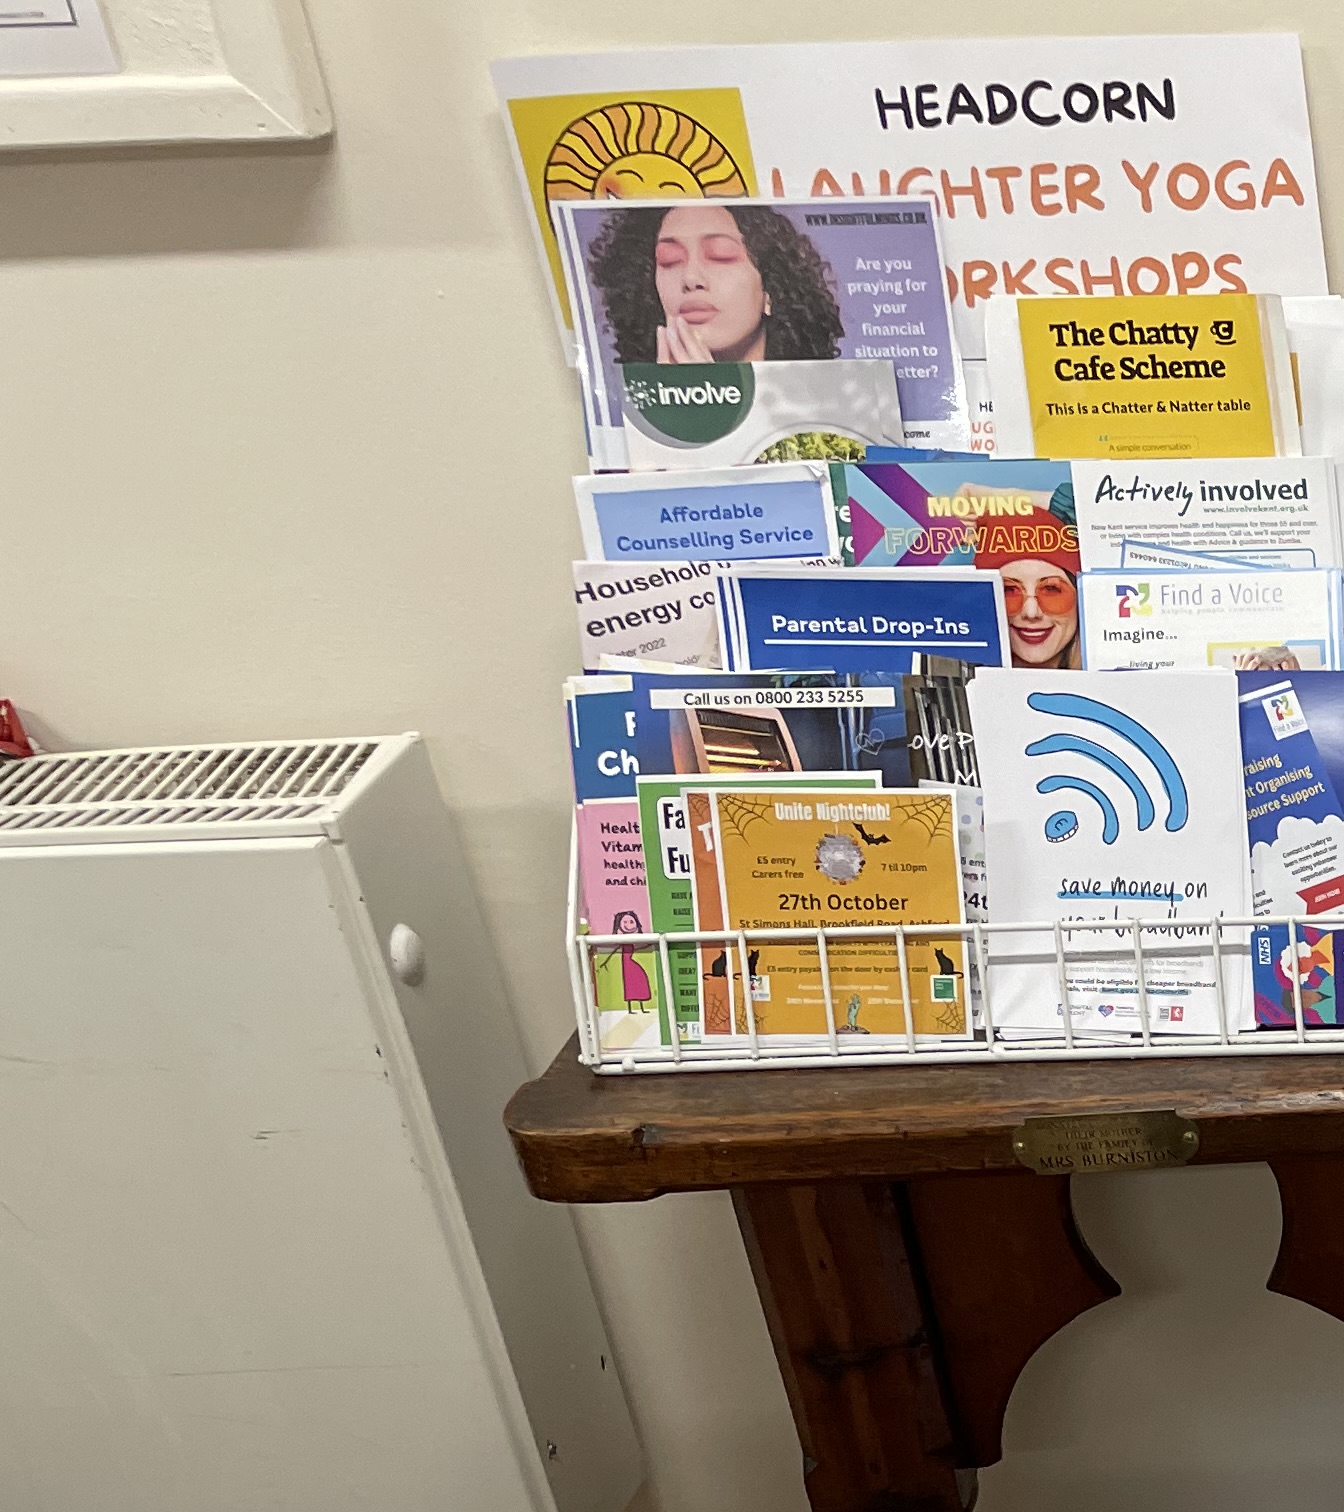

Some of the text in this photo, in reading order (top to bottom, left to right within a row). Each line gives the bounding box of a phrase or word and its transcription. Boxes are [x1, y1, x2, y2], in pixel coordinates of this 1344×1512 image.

[875, 78, 1177, 131] HEADCORN
[1121, 157, 1305, 214] YOGA
[855, 257, 912, 275] Are you
[847, 277, 928, 296] praying for
[872, 302, 907, 318] your
[861, 321, 926, 337] financial
[1049, 319, 1199, 351] The Chatty
[854, 344, 939, 359] situation to
[1054, 354, 1227, 382] Cafe Scheme
[657, 381, 743, 406] involve
[1046, 398, 1252, 416] This Chatter & Natter table
[926, 495, 1035, 518] MOVING
[1095, 474, 1309, 517] Actively involved
[659, 502, 765, 524] Affordable
[616, 528, 736, 553] Counselling
[739, 526, 815, 546] Service
[883, 524, 1082, 555] FORWARDS
[1160, 581, 1284, 606] Find a Voice
[586, 599, 682, 638] energy
[770, 614, 971, 639] Parental Drop-Ins
[682, 688, 865, 707] Call us on 0800 233 5255
[1255, 764, 1314, 795] Organising
[1282, 780, 1326, 808] Support
[774, 801, 892, 823] Unite Nightclub!
[770, 856, 797, 867] entry
[899, 863, 928, 875] 10pm
[751, 870, 783, 880] Carers
[777, 892, 910, 912] 27th October
[1060, 876, 1208, 908] save money on
[752, 918, 791, 930] Simons
[1260, 938, 1271, 964] NHS
[1039, 1154, 1075, 1170] MRS
